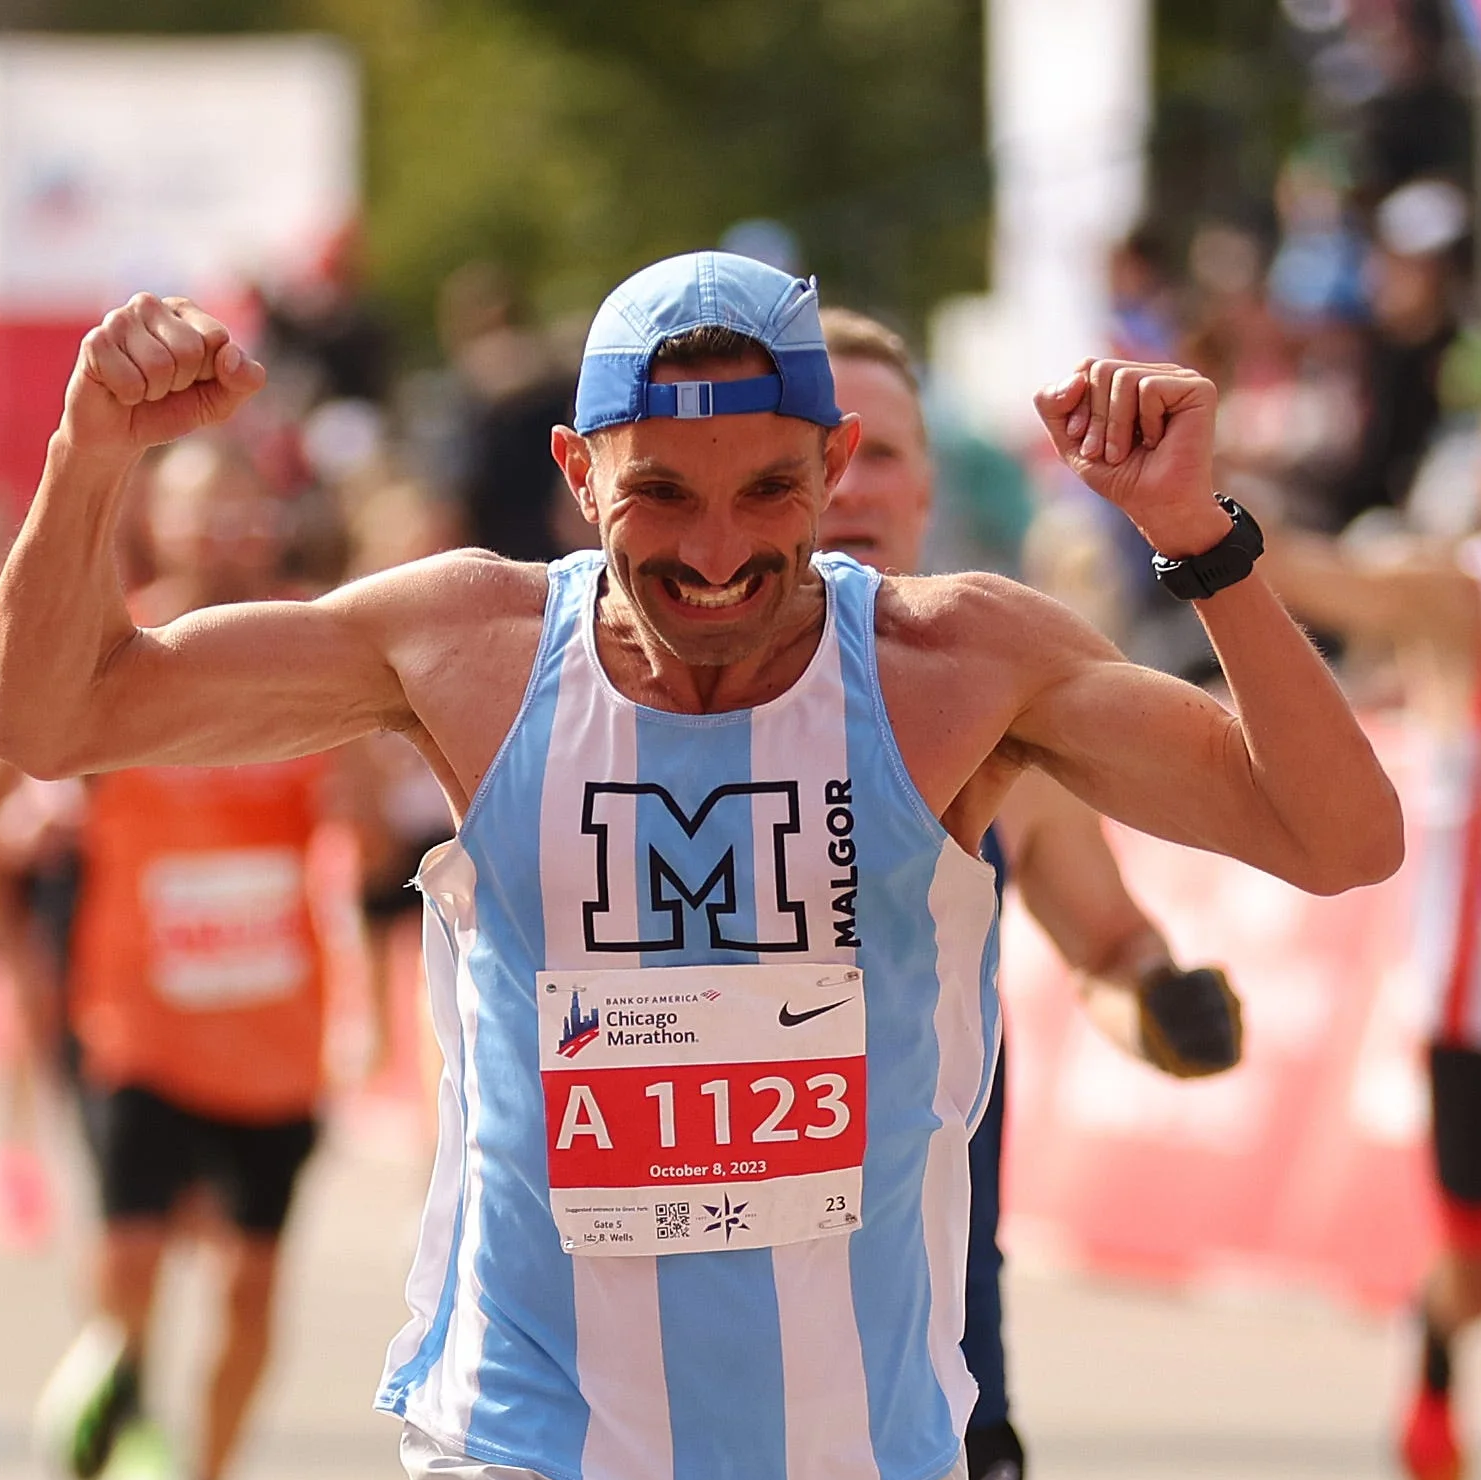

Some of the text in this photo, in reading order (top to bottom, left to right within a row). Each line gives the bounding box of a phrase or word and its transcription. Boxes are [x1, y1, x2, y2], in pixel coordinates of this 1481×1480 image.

[581, 781, 809, 952] M
[824, 778, 862, 948] MALGOR
[636, 996, 650, 1005] OF
[652, 994, 699, 1004] AMERICA
[606, 1011, 678, 1029] Chicago
[556, 1073, 851, 1150] A 1123
[649, 1160, 767, 1178] October 8, 2023
[826, 1196, 846, 1212] 23
[593, 1220, 622, 1229] Gate 5
[610, 1233, 634, 1242] Wells
